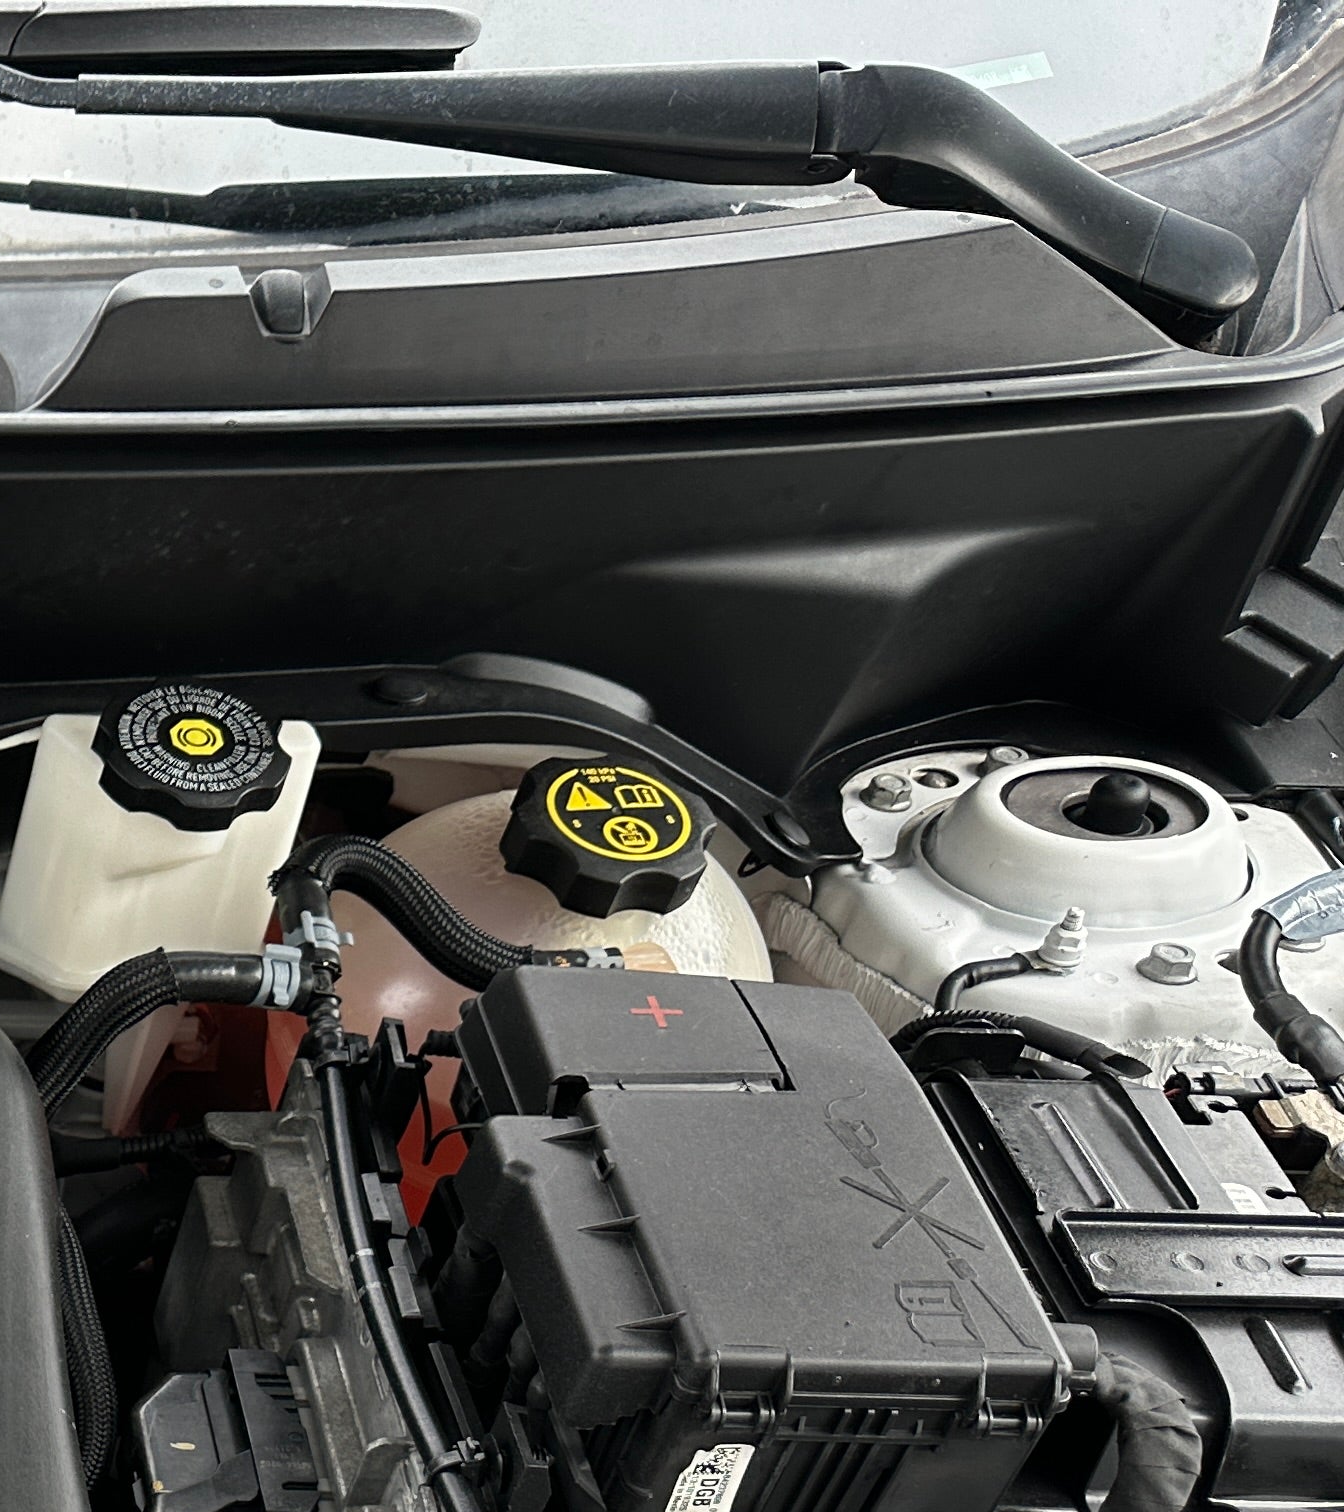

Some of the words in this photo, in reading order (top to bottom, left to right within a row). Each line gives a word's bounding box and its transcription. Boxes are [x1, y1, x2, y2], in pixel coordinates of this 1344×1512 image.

[139, 746, 156, 759] CAP
[151, 758, 185, 779] BEFORE
[196, 761, 227, 773] CLEAN
[143, 765, 171, 783] FLUID
[169, 777, 198, 791] FROM
[200, 782, 207, 791] A
[207, 778, 242, 792] SEALED
[692, 1478, 720, 1507] DGB
